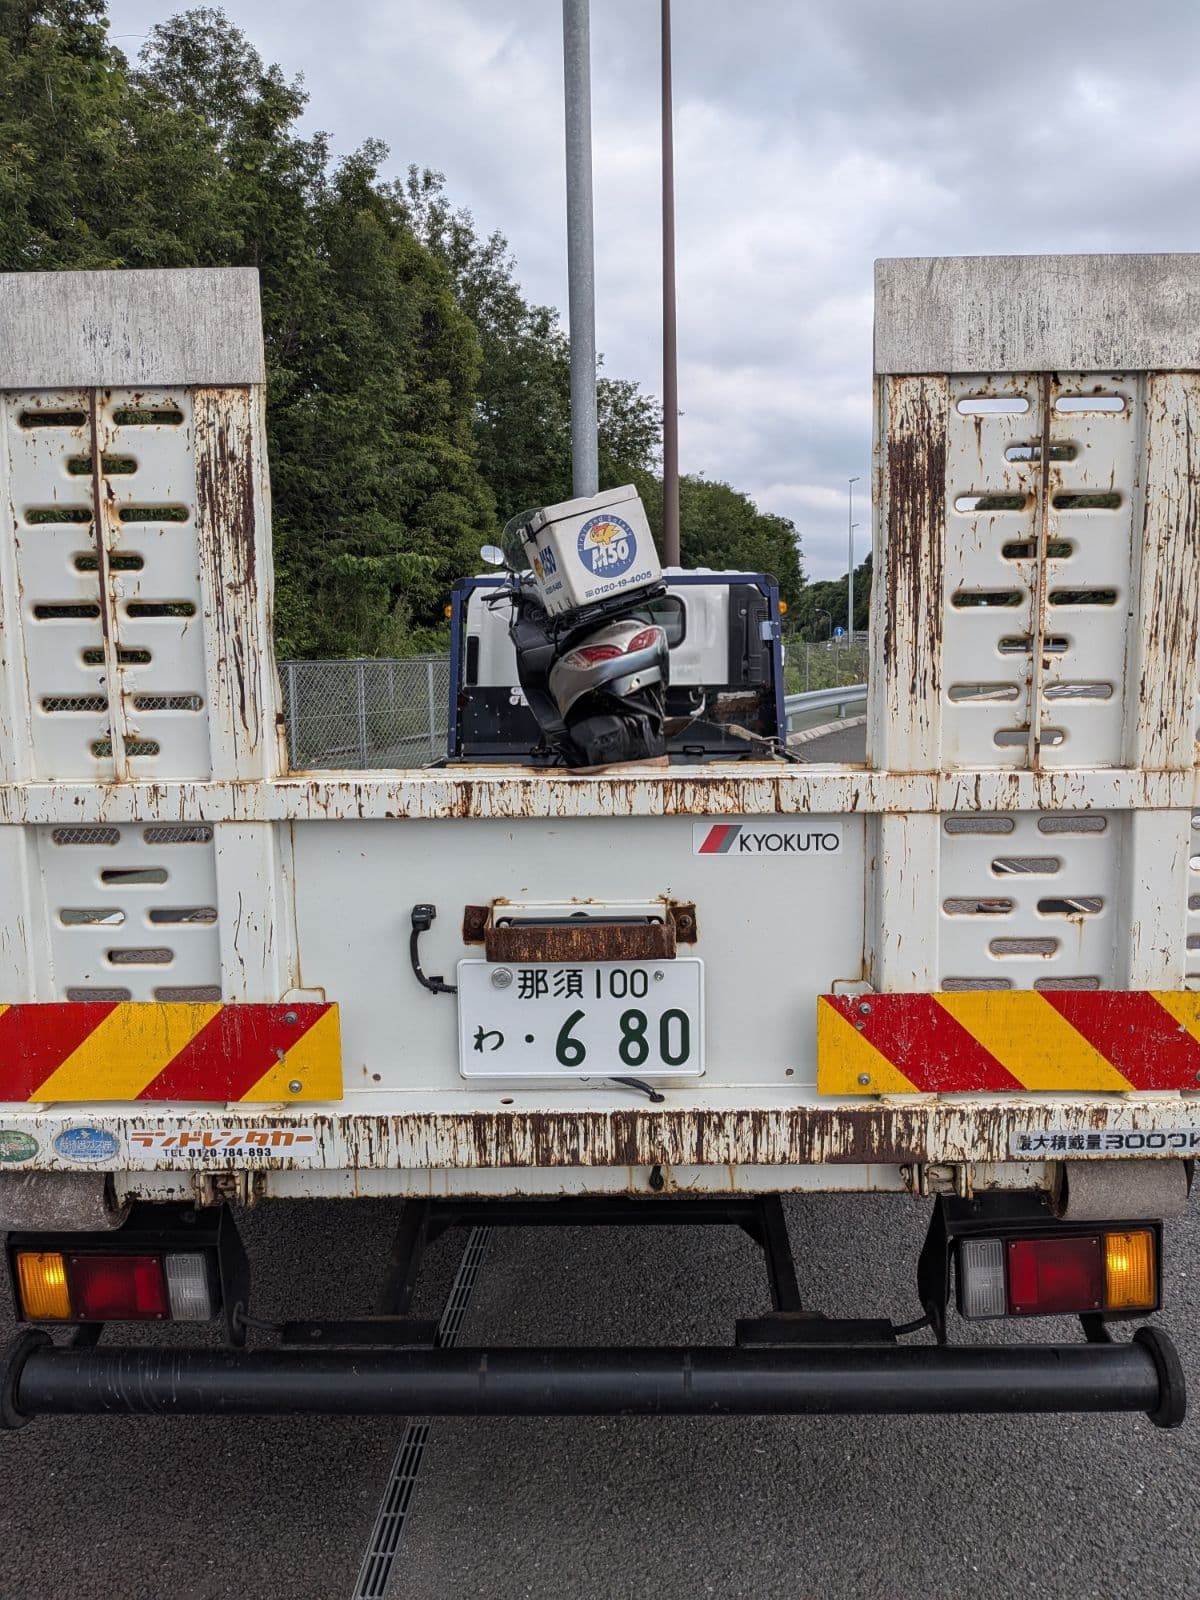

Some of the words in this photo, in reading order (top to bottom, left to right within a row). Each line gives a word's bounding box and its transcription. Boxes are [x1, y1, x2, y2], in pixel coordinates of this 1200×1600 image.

[739, 833, 840, 852] KYOKUTO
[473, 1025, 505, 1053] わ
[130, 1130, 313, 1147] ランドレンタカー
[164, 1149, 185, 1157] TEL
